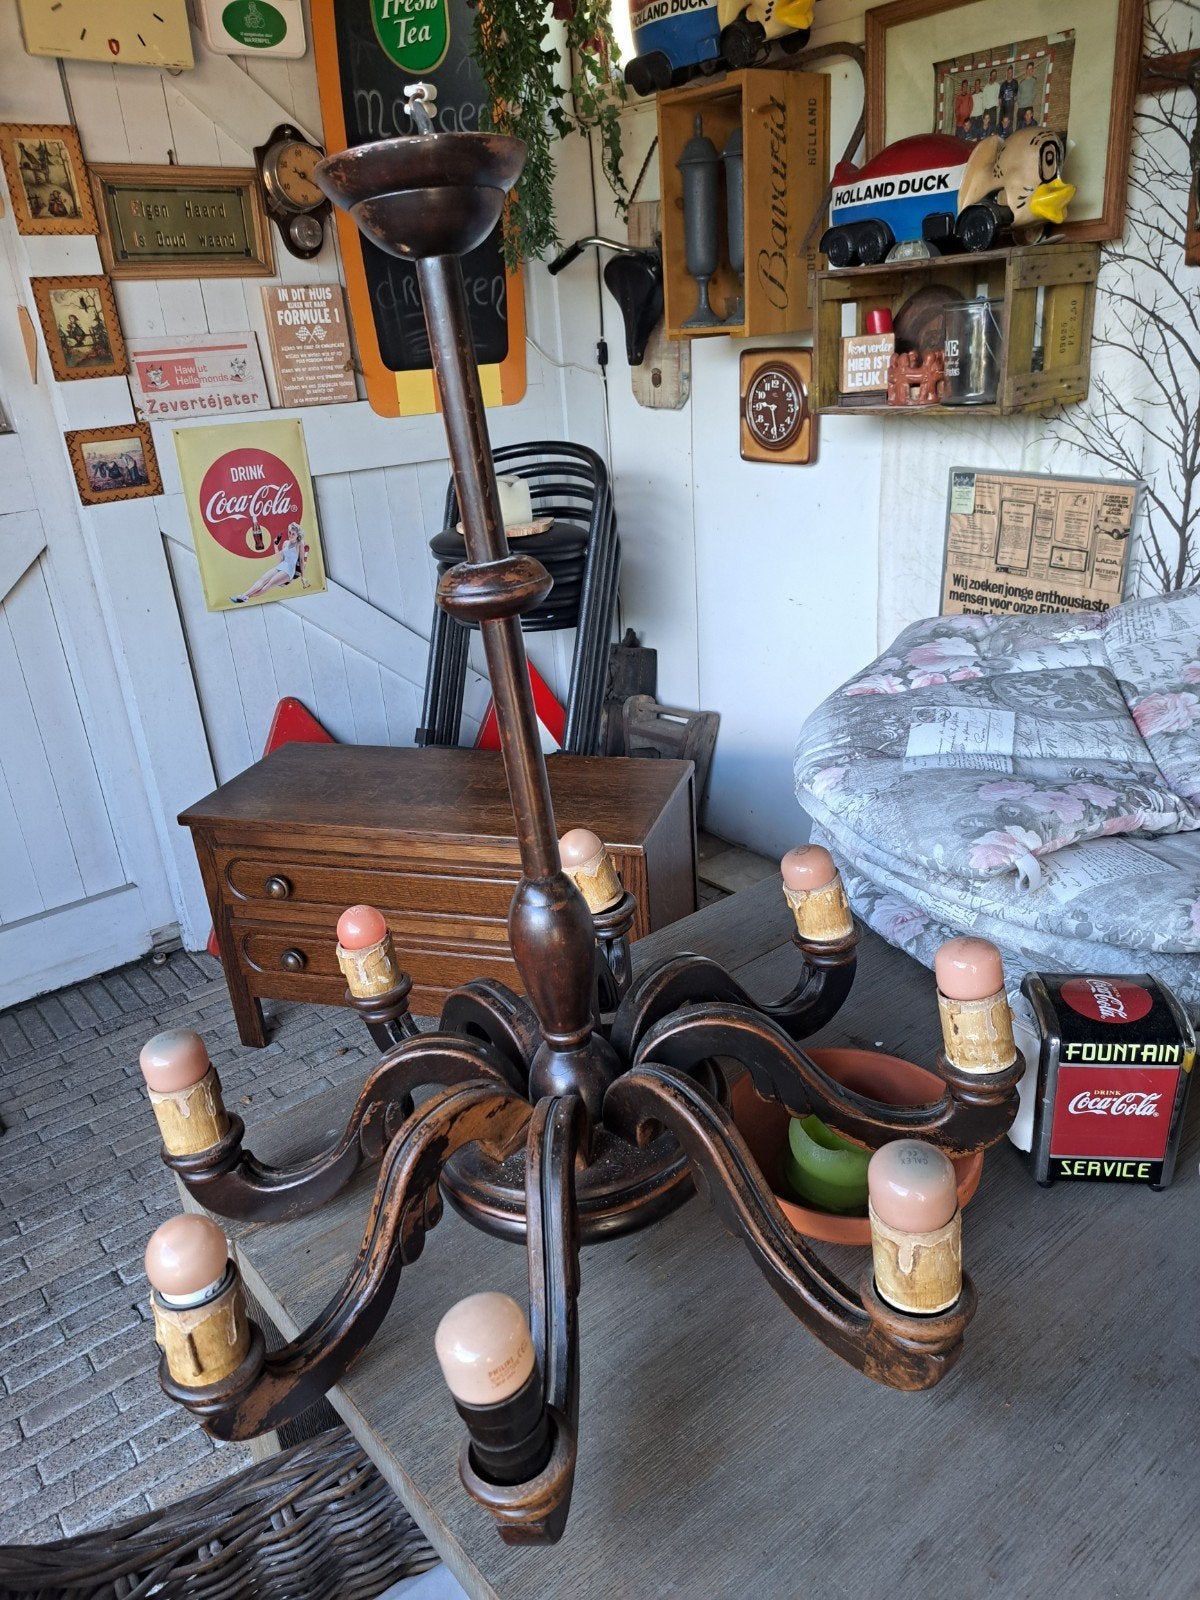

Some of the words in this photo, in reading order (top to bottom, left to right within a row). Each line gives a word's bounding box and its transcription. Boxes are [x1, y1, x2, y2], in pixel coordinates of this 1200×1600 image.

[393, 16, 432, 48] Tea
[807, 98, 818, 166] HOLLAND
[834, 181, 895, 206] HOLLAND
[897, 173, 951, 195] DUCK
[278, 288, 289, 302] IN
[291, 287, 306, 301] DIT
[308, 287, 332, 300] HUIS
[276, 307, 332, 326] FORMULE
[333, 307, 340, 323] 1
[174, 364, 197, 375] Haw
[198, 364, 208, 373] ut
[847, 357, 871, 371] HIER
[176, 373, 229, 386] Hellemonds
[771, 380, 780, 389] 12
[847, 371, 880, 388] LEUK
[147, 392, 259, 414] Zevertéjater
[758, 391, 766, 399] 10
[785, 392, 793, 401] 2
[787, 403, 794, 413] 3
[757, 415, 764, 423] 8
[763, 422, 770, 431] 7
[784, 416, 791, 425] 4
[779, 424, 785, 433] 5
[230, 464, 266, 483] DRINK
[205, 482, 293, 524] Coca-Cola
[949, 589, 988, 606] mensen
[989, 597, 1012, 611] voor
[1012, 601, 1038, 614] onze
[953, 573, 967, 590] Wij
[968, 579, 1004, 594] zoeken
[1003, 582, 1033, 602] jonge
[1035, 588, 1110, 613] enthousiaste
[1065, 1042, 1179, 1063] FOUNTAIN
[1068, 1091, 1163, 1117] Coca-Cola
[1061, 1160, 1152, 1178] SERVICE
